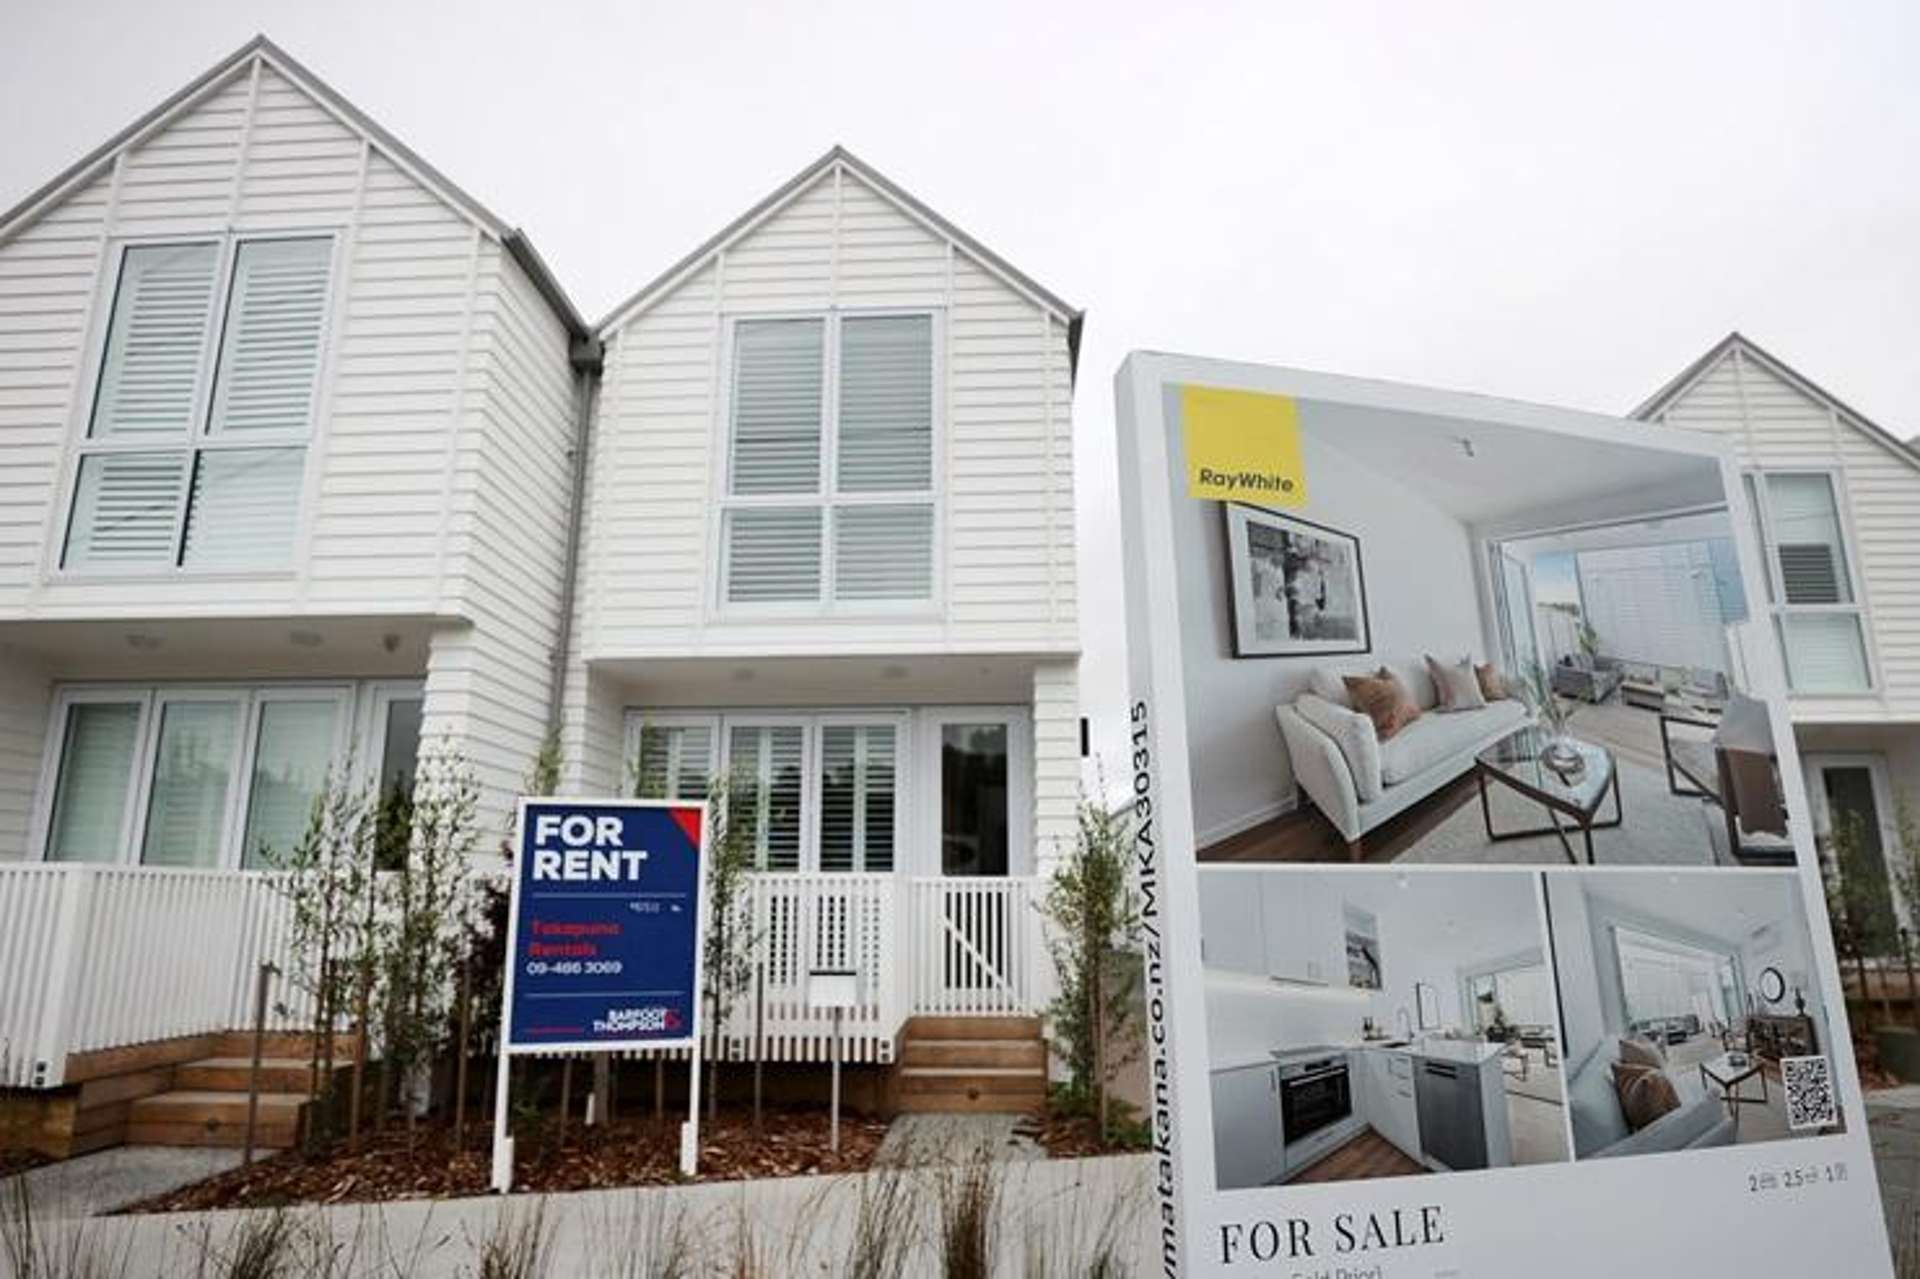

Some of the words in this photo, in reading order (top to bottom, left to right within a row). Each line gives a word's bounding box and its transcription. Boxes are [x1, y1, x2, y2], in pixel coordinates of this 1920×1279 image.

[1199, 467, 1295, 492] RayWhite
[535, 814, 624, 846] FOR
[532, 850, 648, 880] RENT
[1219, 1218, 1315, 1264] FOR
[1334, 1205, 1445, 1252] SALE
